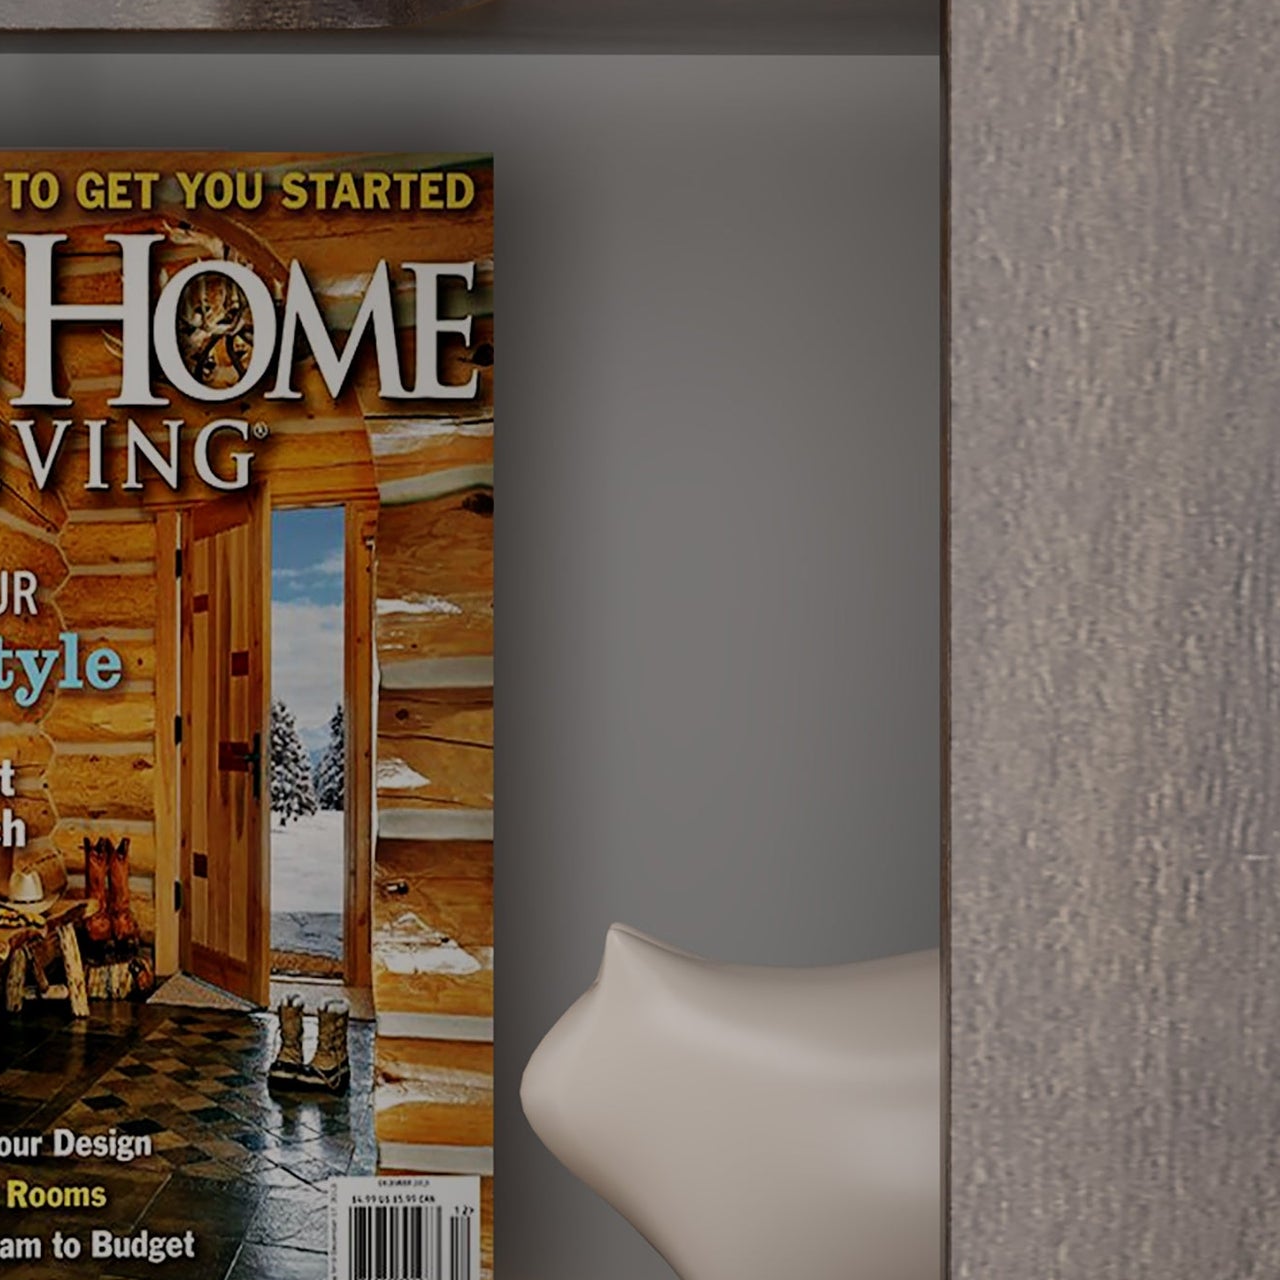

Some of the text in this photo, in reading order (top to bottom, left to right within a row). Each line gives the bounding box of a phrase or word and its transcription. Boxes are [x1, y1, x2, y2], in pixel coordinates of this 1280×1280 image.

[3, 172, 58, 210] TO
[76, 172, 161, 210] GET
[175, 172, 264, 210] YOU
[283, 172, 475, 210] STARTED
[54, 1129, 153, 1162] Design
[7, 1181, 107, 1208] Rooms
[51, 1234, 80, 1259] to
[91, 1230, 196, 1263] Budget
